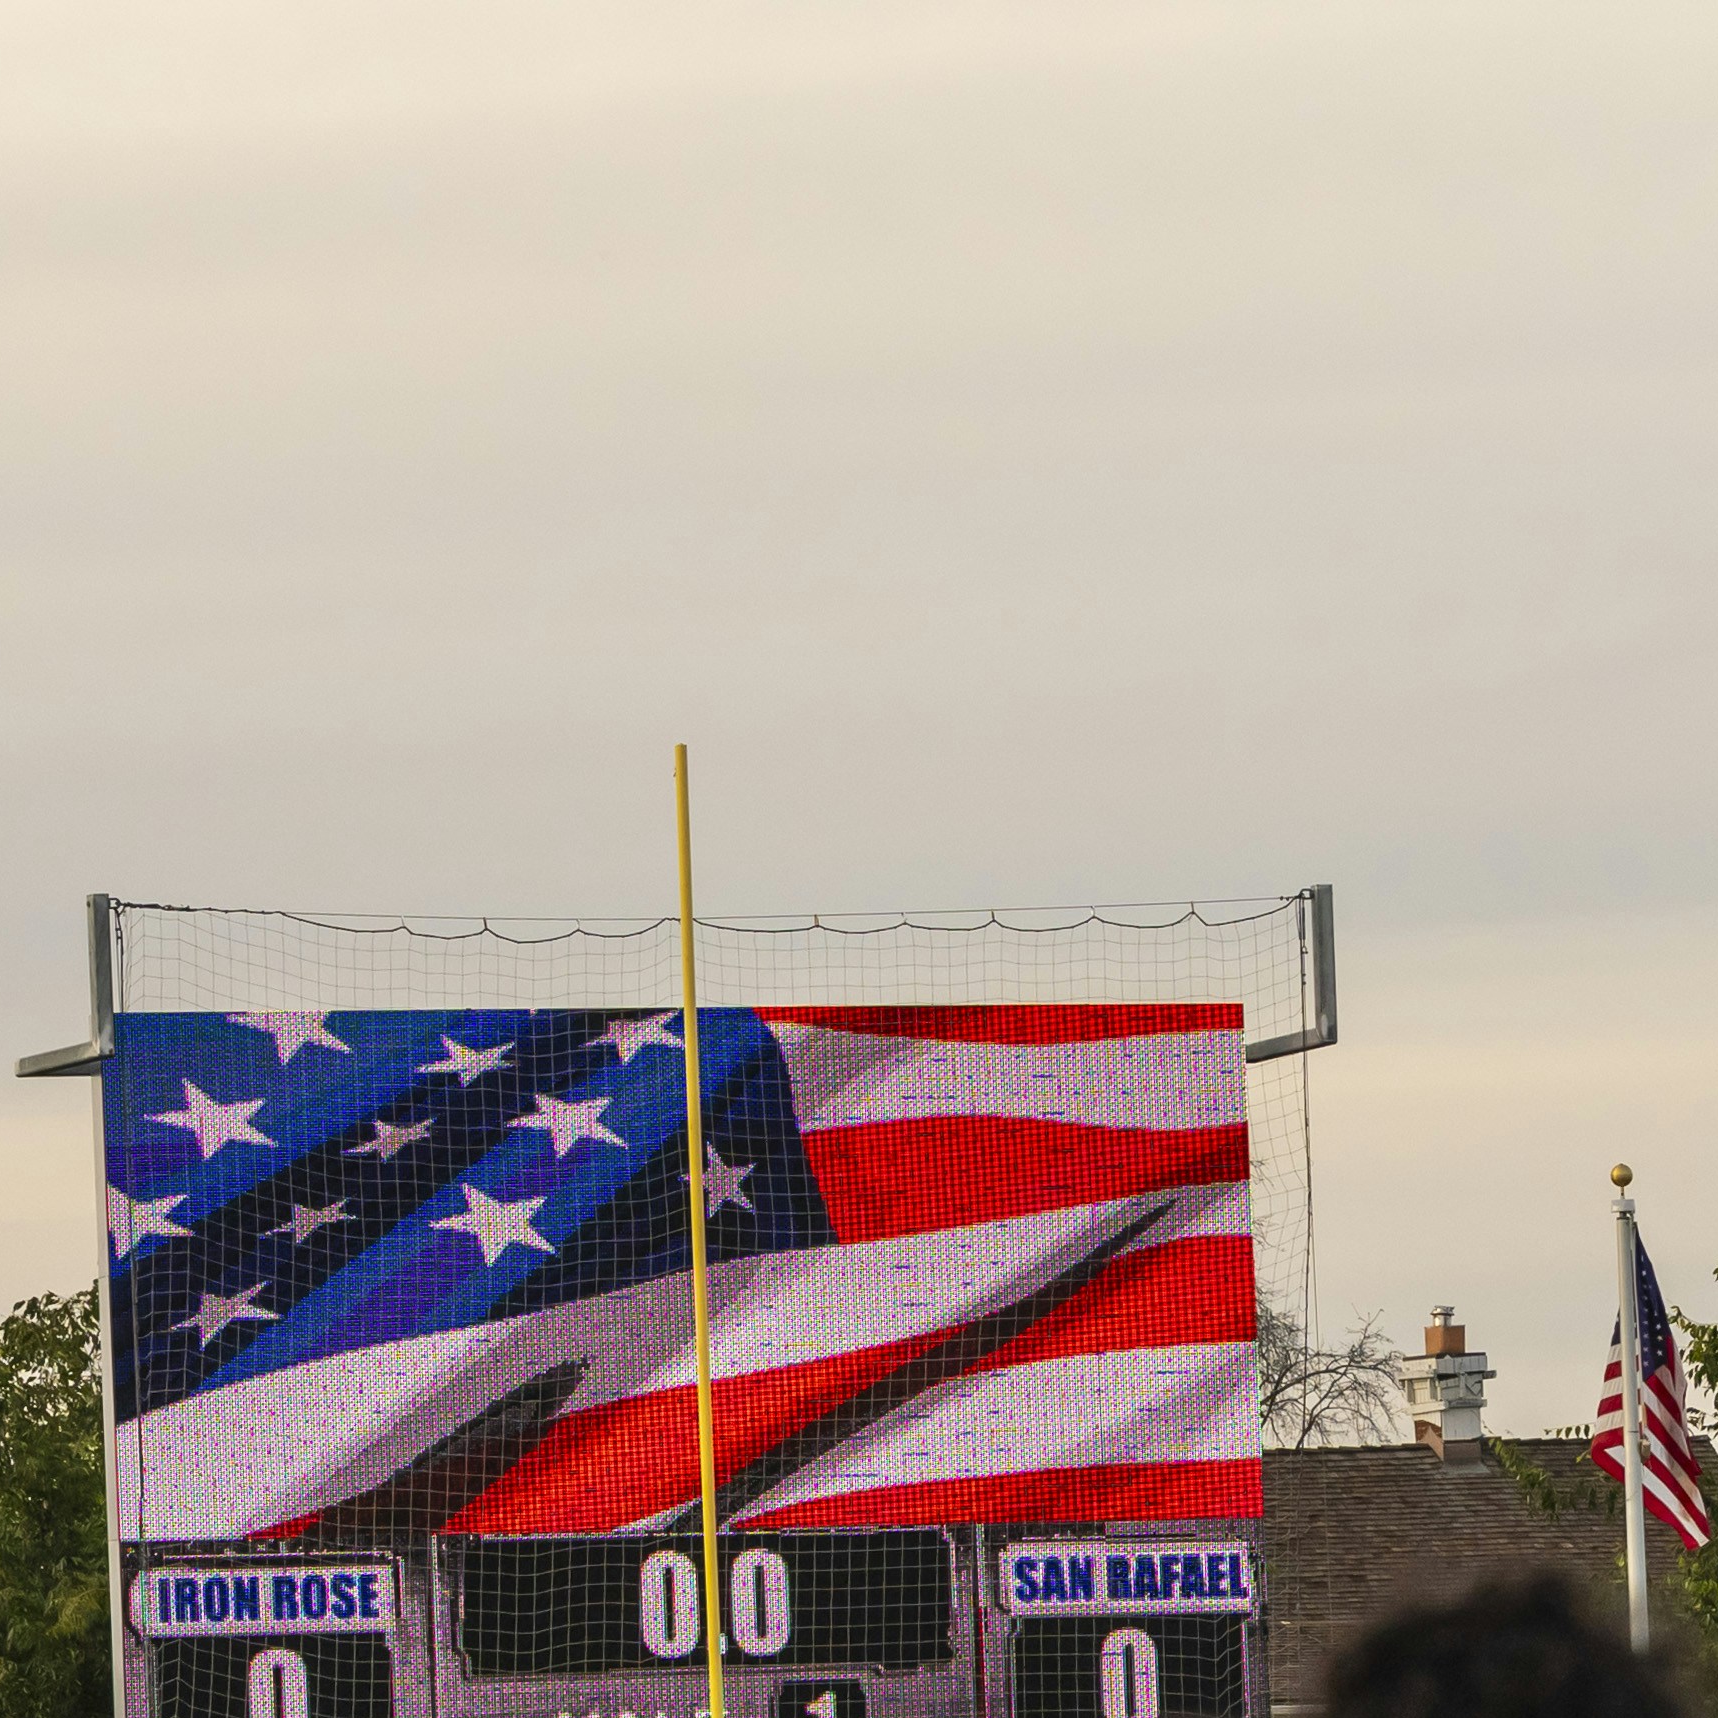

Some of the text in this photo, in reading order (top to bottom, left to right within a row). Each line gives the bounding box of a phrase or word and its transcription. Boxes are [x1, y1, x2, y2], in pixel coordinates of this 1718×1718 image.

[157, 1573, 380, 1623] IRON ROSE
[1013, 1553, 1249, 1602] SAN RAFAEL
